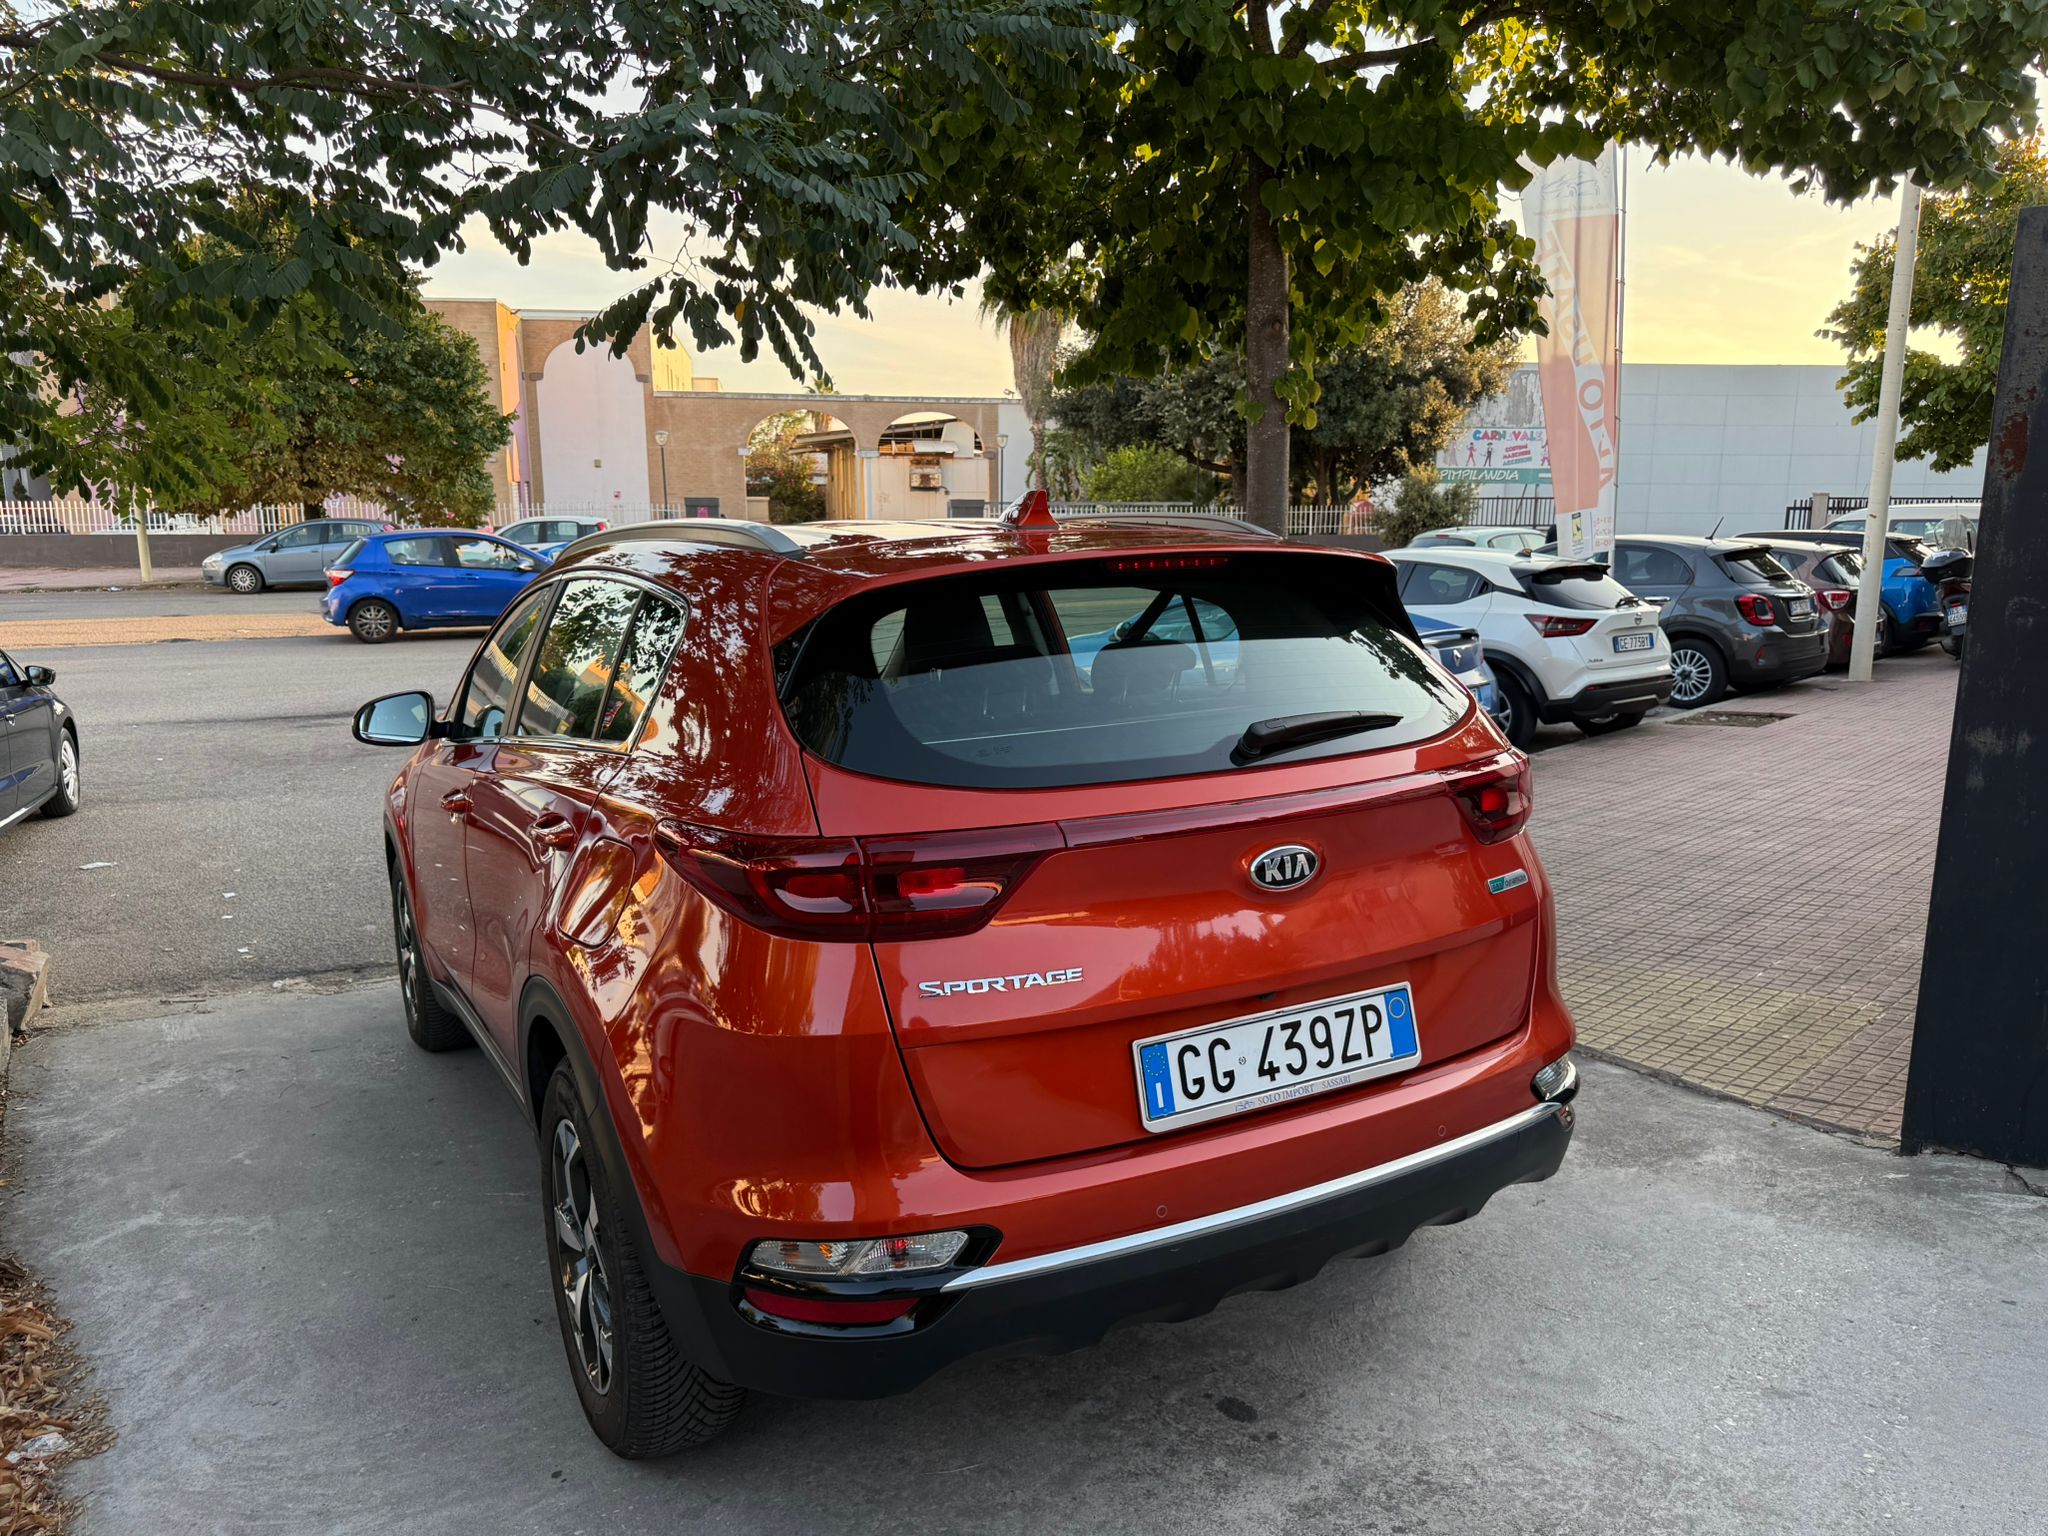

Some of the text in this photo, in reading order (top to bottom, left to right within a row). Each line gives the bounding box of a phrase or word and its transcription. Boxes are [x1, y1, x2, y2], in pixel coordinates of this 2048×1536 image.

[1473, 430, 1543, 441] CARNEVALE
[1440, 470, 1519, 480] PIMPILANDIA
[1264, 853, 1310, 882] KIA
[919, 967, 1083, 998] SPORTAGE
[1258, 1075, 1351, 1105] SOLO IMPORT SASSARI
